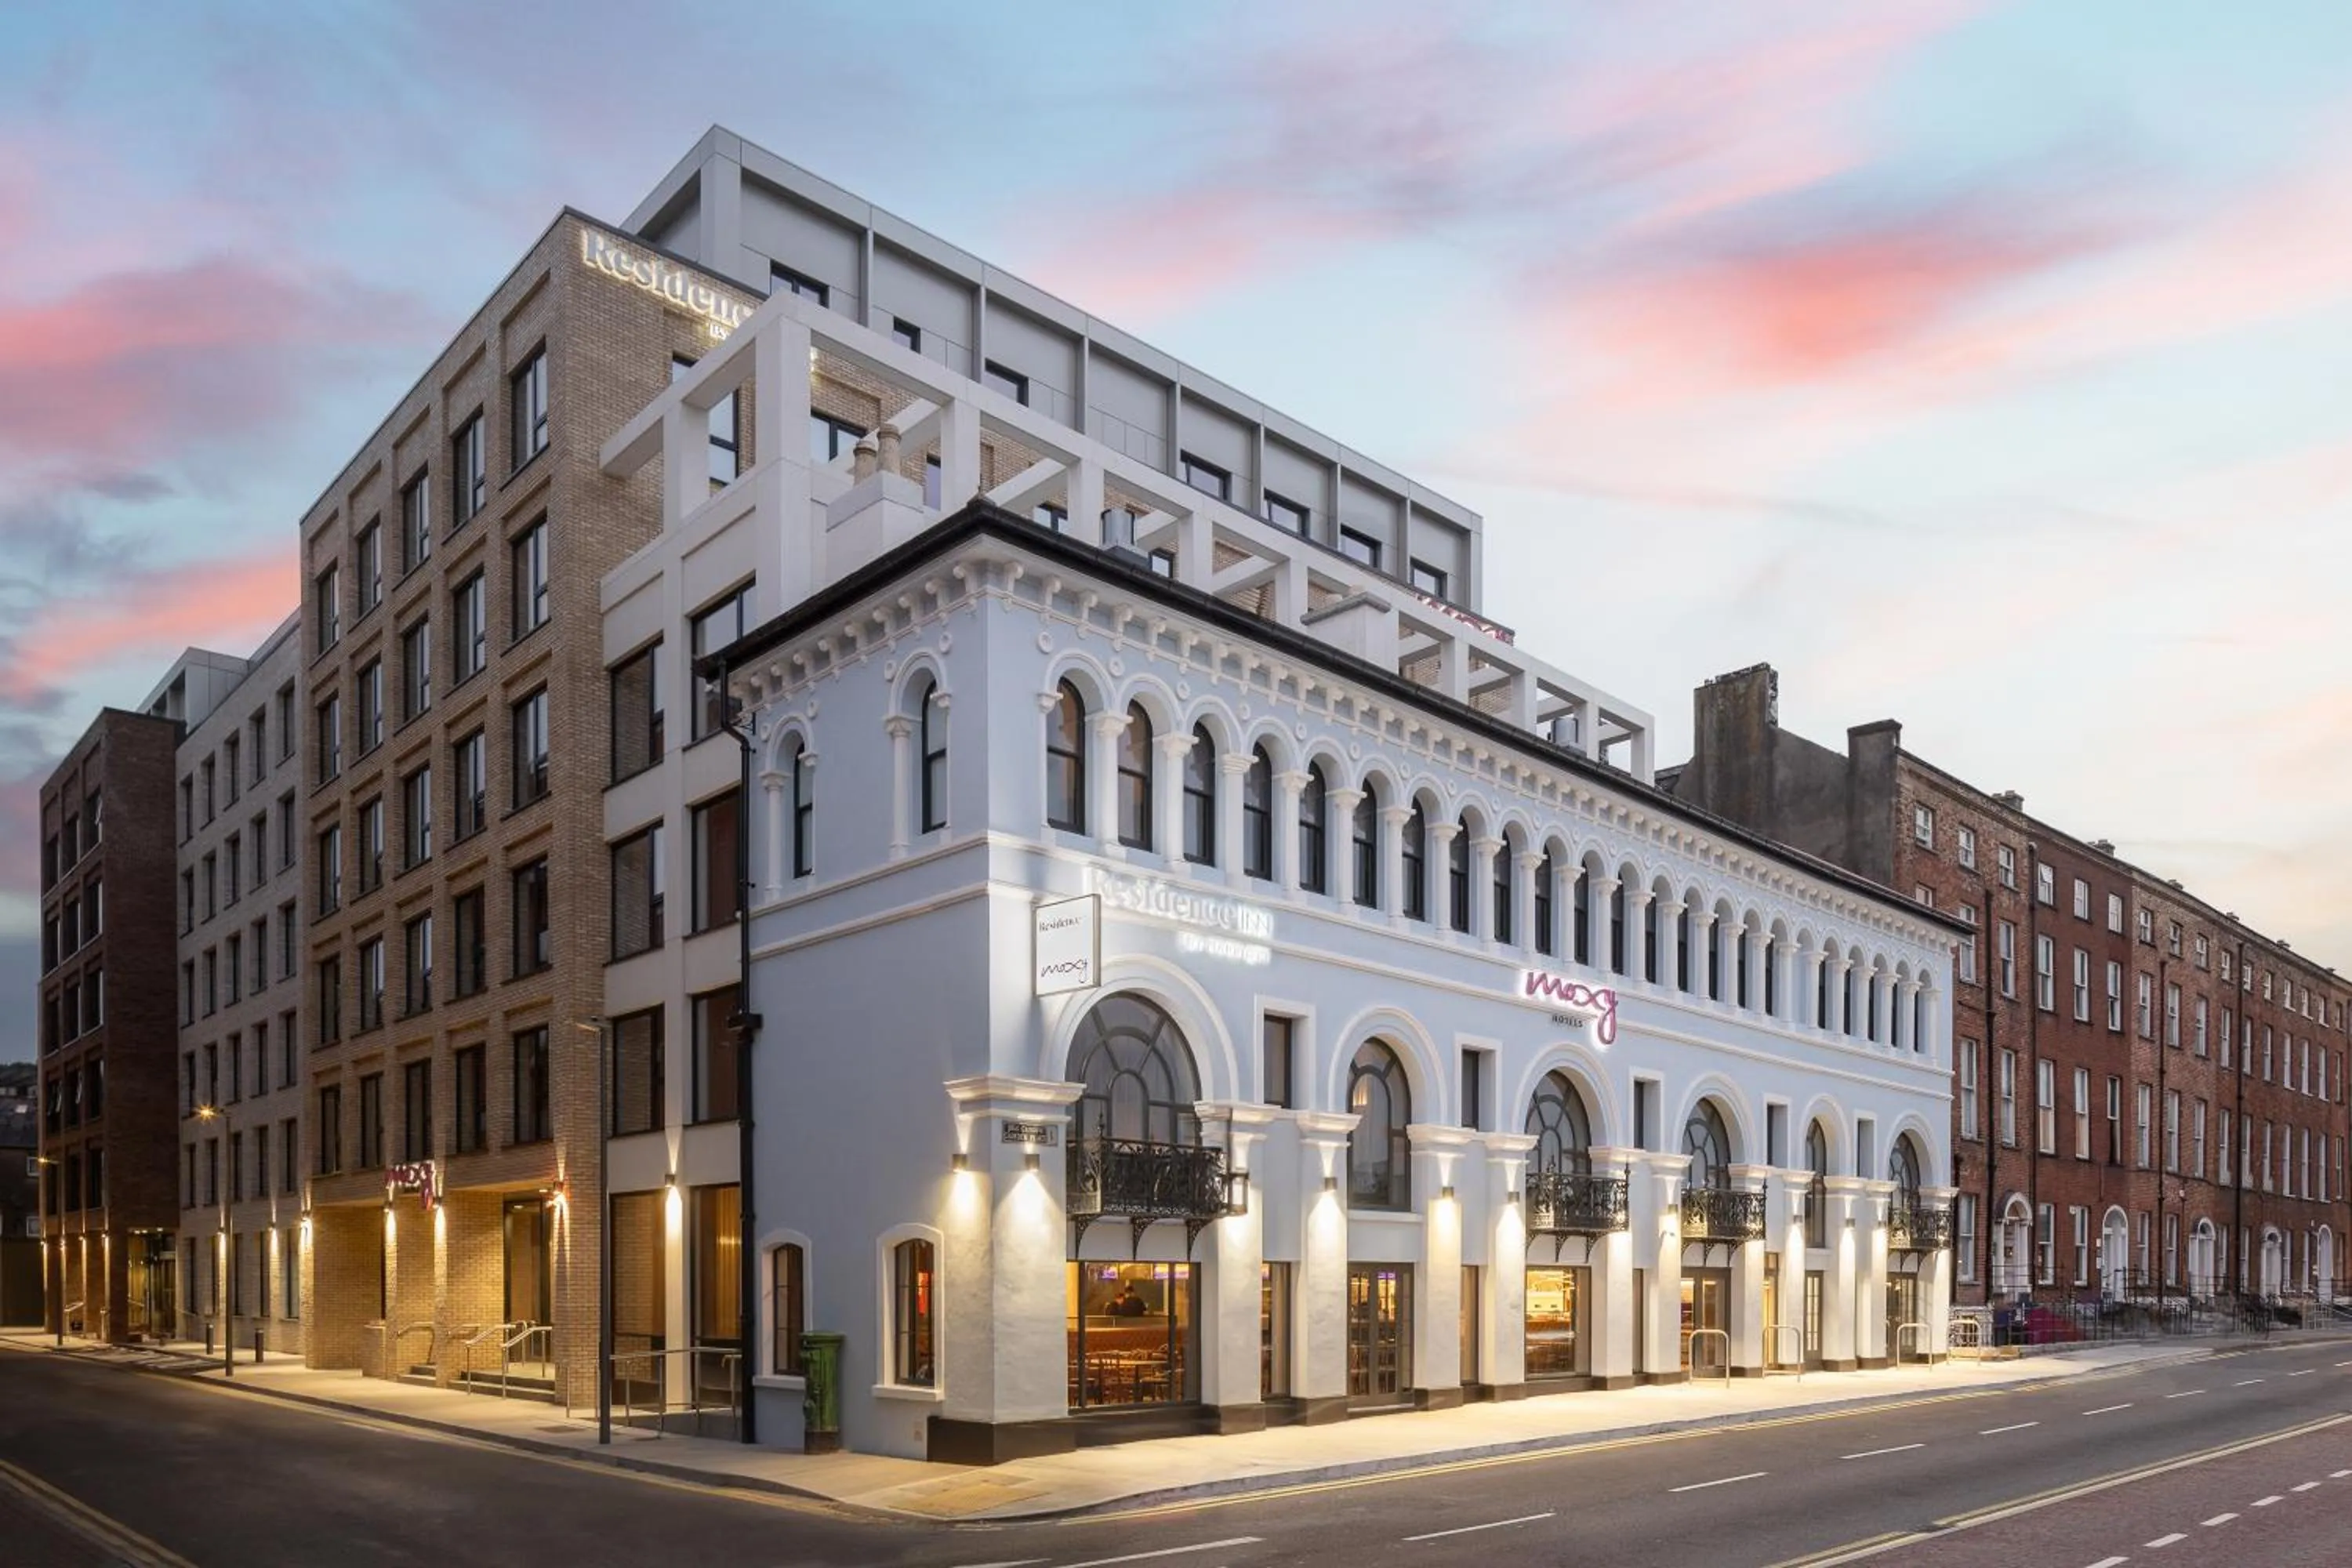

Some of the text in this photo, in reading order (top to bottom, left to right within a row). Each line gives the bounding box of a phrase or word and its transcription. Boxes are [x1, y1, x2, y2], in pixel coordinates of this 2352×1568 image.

[581, 228, 755, 328] Residenc
[1088, 868, 1232, 928] Residence
[1525, 971, 1619, 1045] moxy
